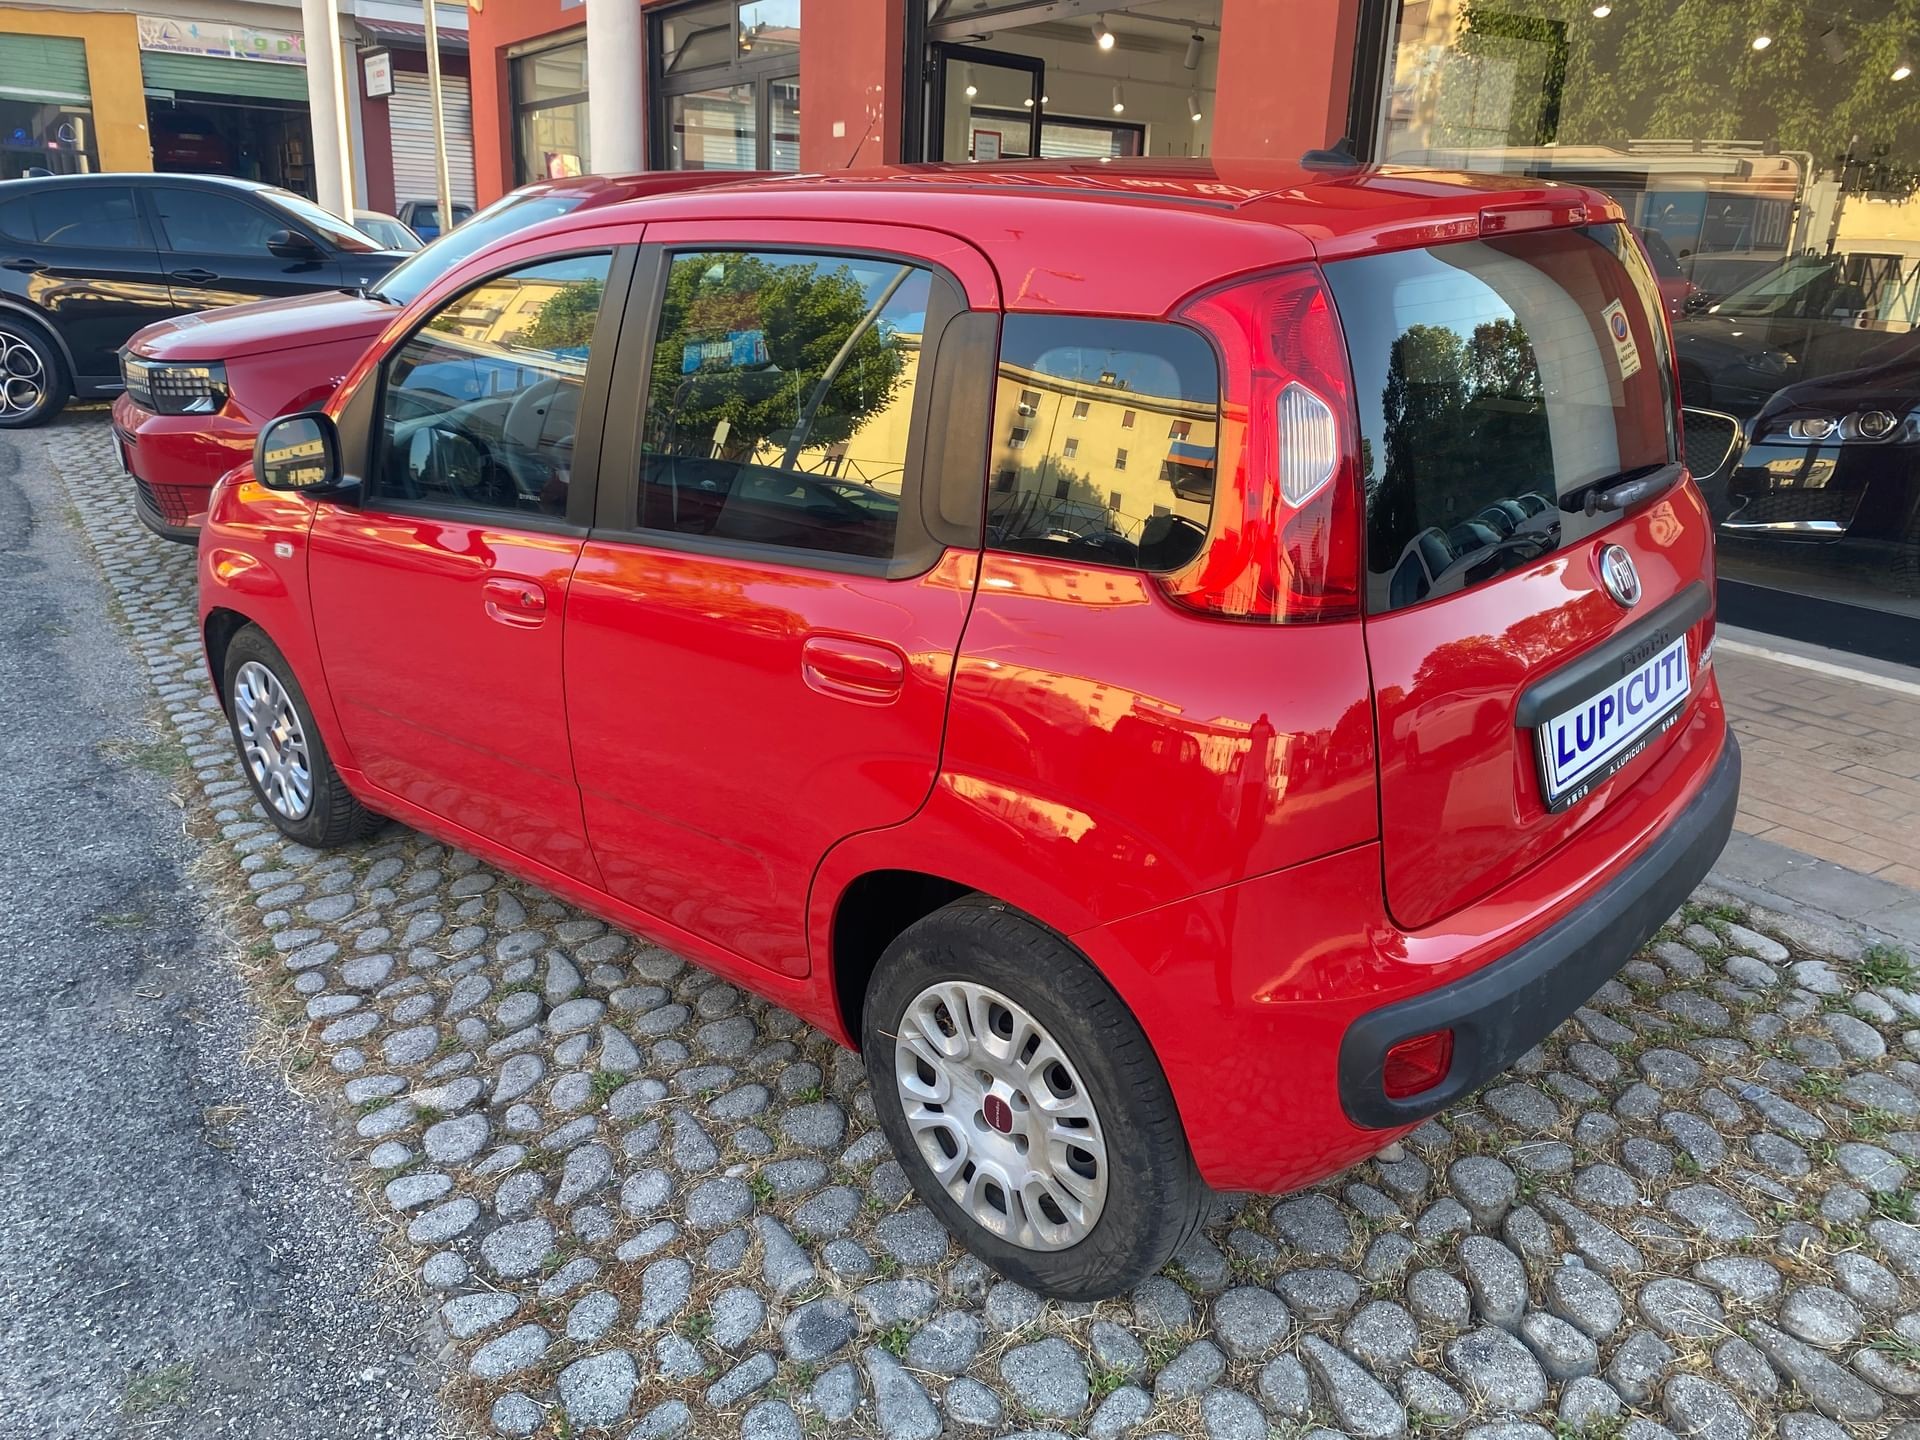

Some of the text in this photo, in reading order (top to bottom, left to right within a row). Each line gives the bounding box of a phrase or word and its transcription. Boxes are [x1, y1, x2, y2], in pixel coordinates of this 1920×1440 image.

[1756, 200, 1791, 244] FIAT
[1612, 559, 1635, 592] FIAT
[1557, 645, 1683, 769] LUPICUTI
[1616, 740, 1646, 769] LUPICUTI
